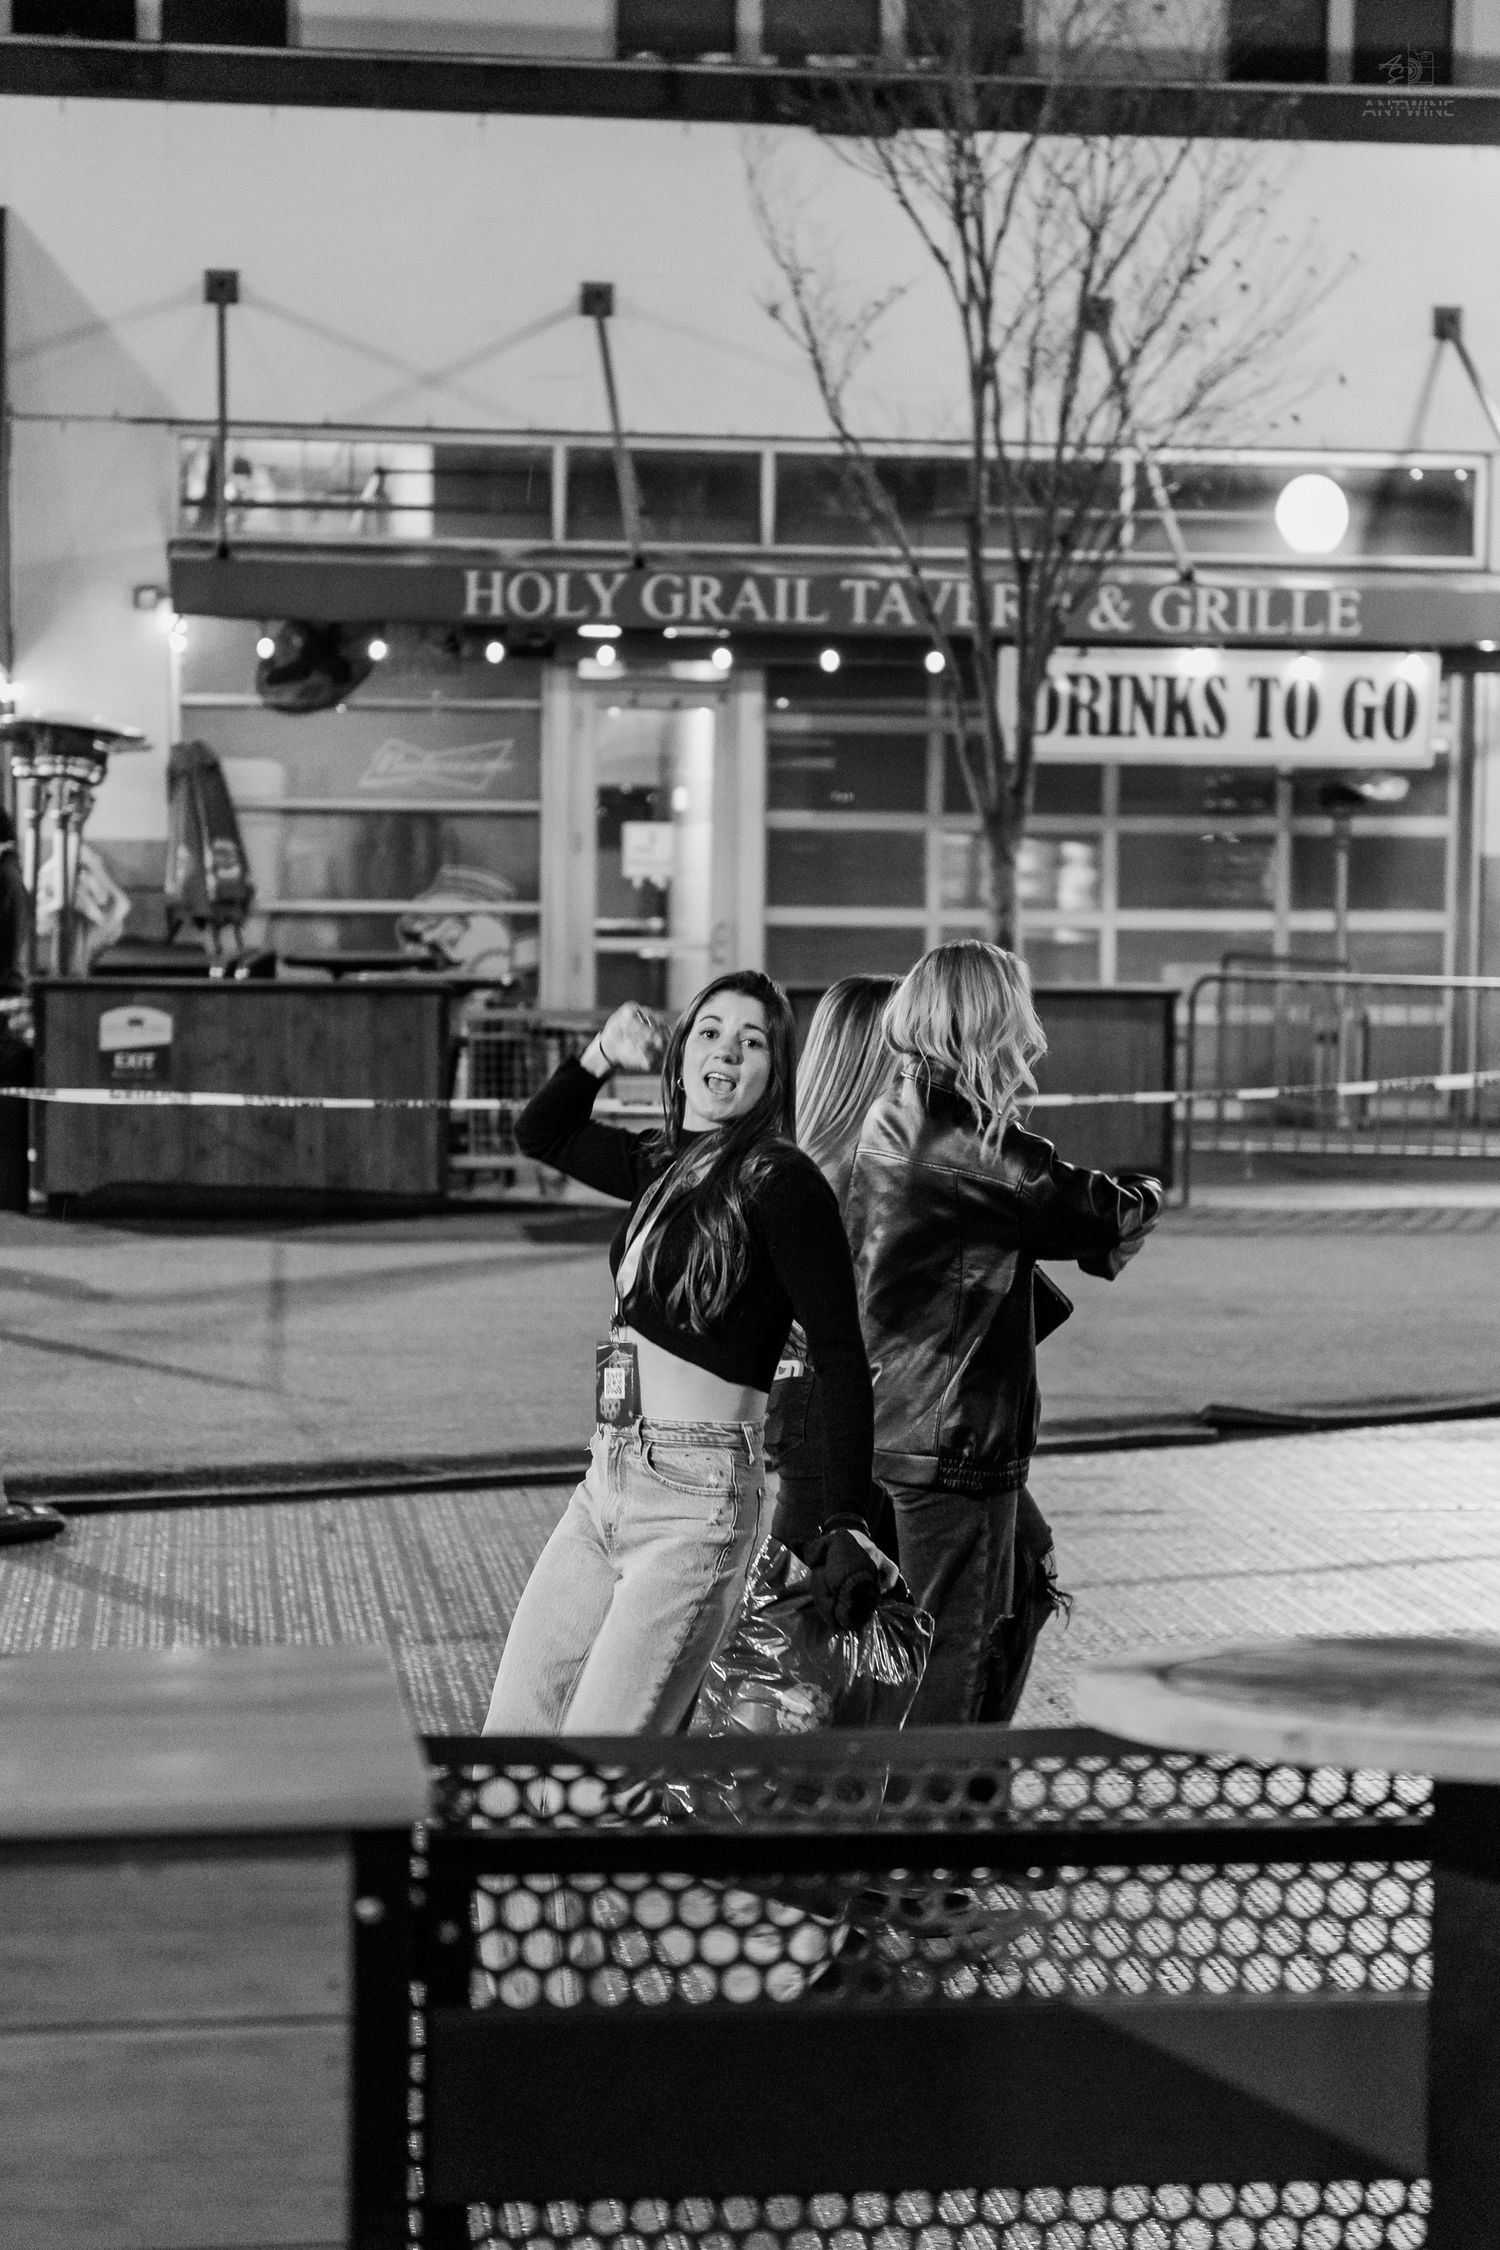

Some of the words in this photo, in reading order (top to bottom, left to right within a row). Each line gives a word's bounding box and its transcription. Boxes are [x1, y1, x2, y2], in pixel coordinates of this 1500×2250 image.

[464, 569, 627, 618] HOLY
[641, 573, 829, 624] GRAIL
[1089, 584, 1133, 632] &
[1150, 586, 1362, 637] GRILLE
[1036, 673, 1227, 739] DRINKS
[1248, 677, 1319, 740] TO
[1342, 677, 1417, 742] GO
